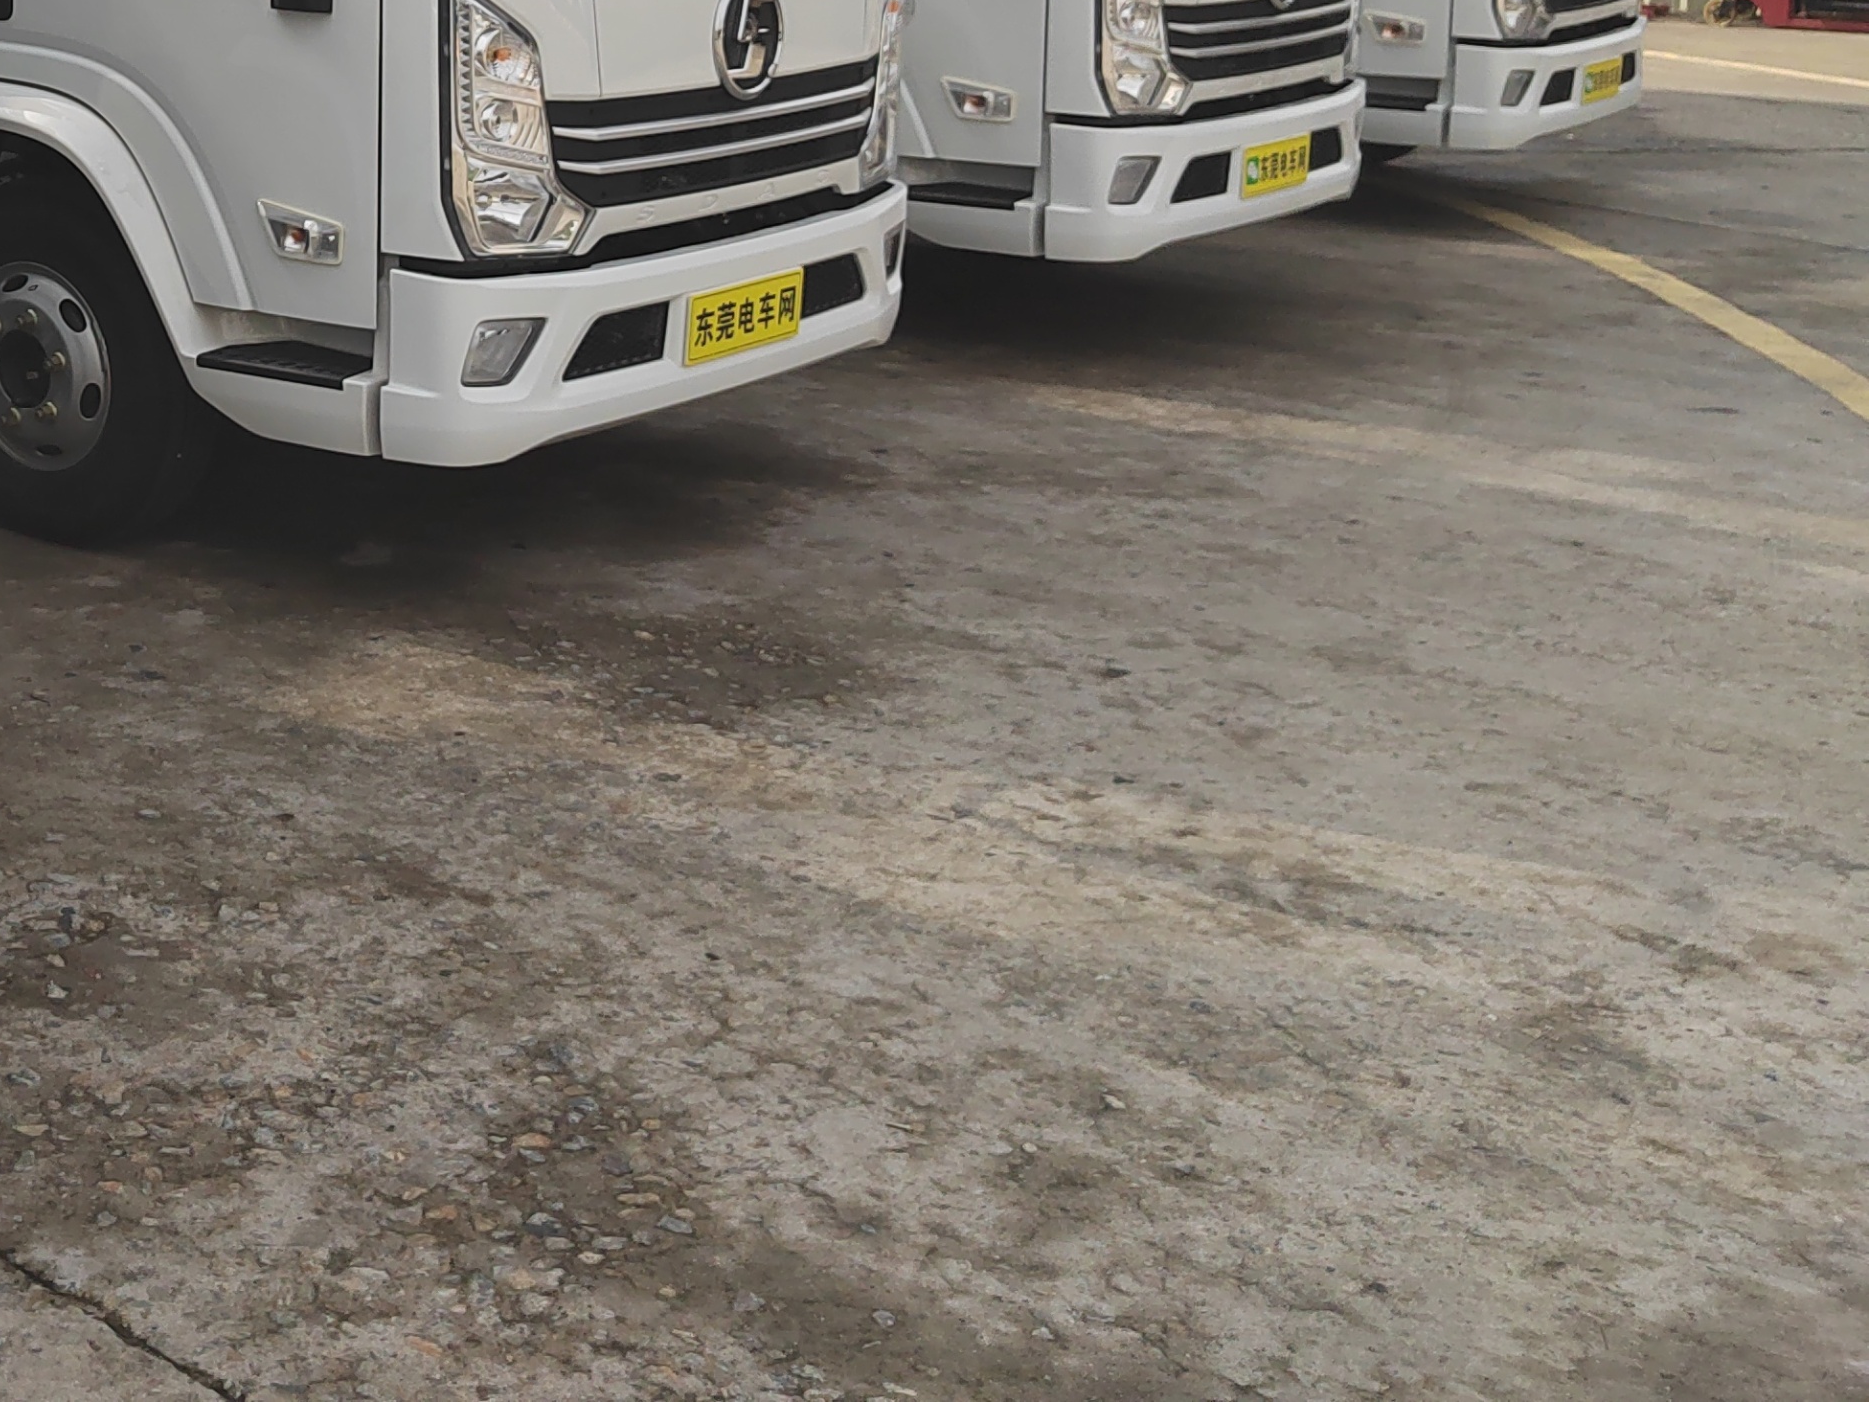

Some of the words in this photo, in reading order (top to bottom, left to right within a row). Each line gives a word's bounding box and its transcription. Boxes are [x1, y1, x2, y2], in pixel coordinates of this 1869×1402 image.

[694, 285, 797, 348] 东莞电车网
